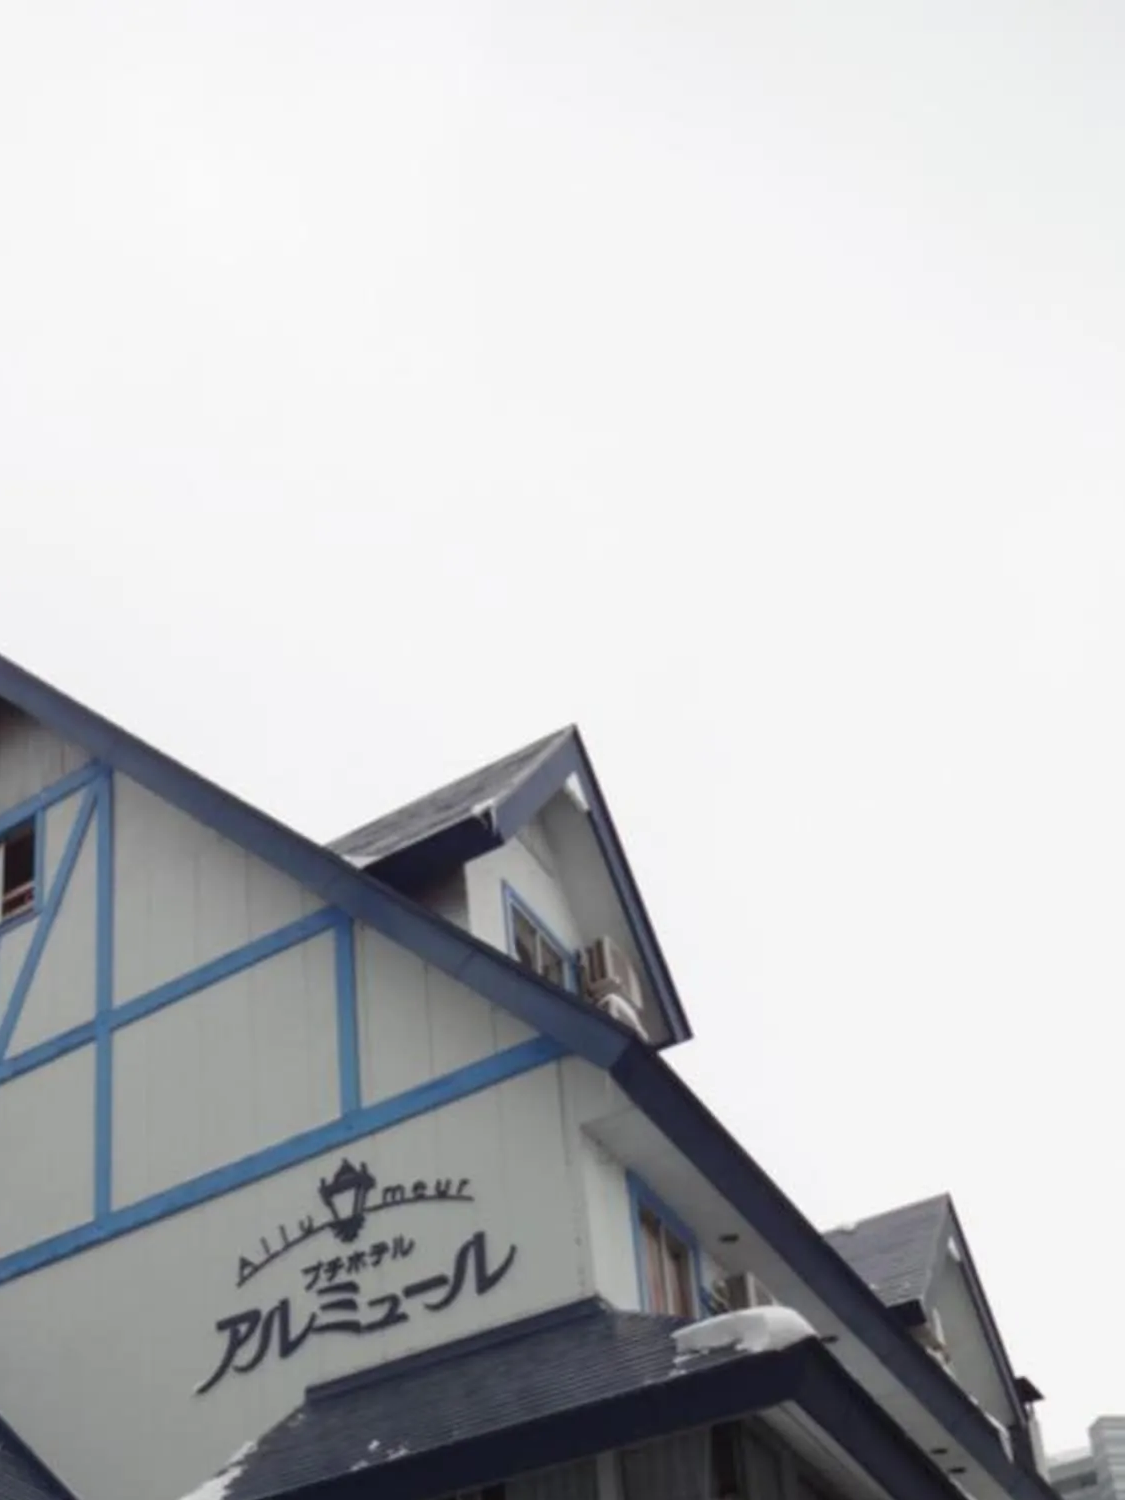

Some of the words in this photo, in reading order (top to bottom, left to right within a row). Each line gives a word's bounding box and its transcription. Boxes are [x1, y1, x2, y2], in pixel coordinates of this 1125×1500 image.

[195, 1230, 518, 1395] アルミュール
[301, 1234, 415, 1292] プチホテル
